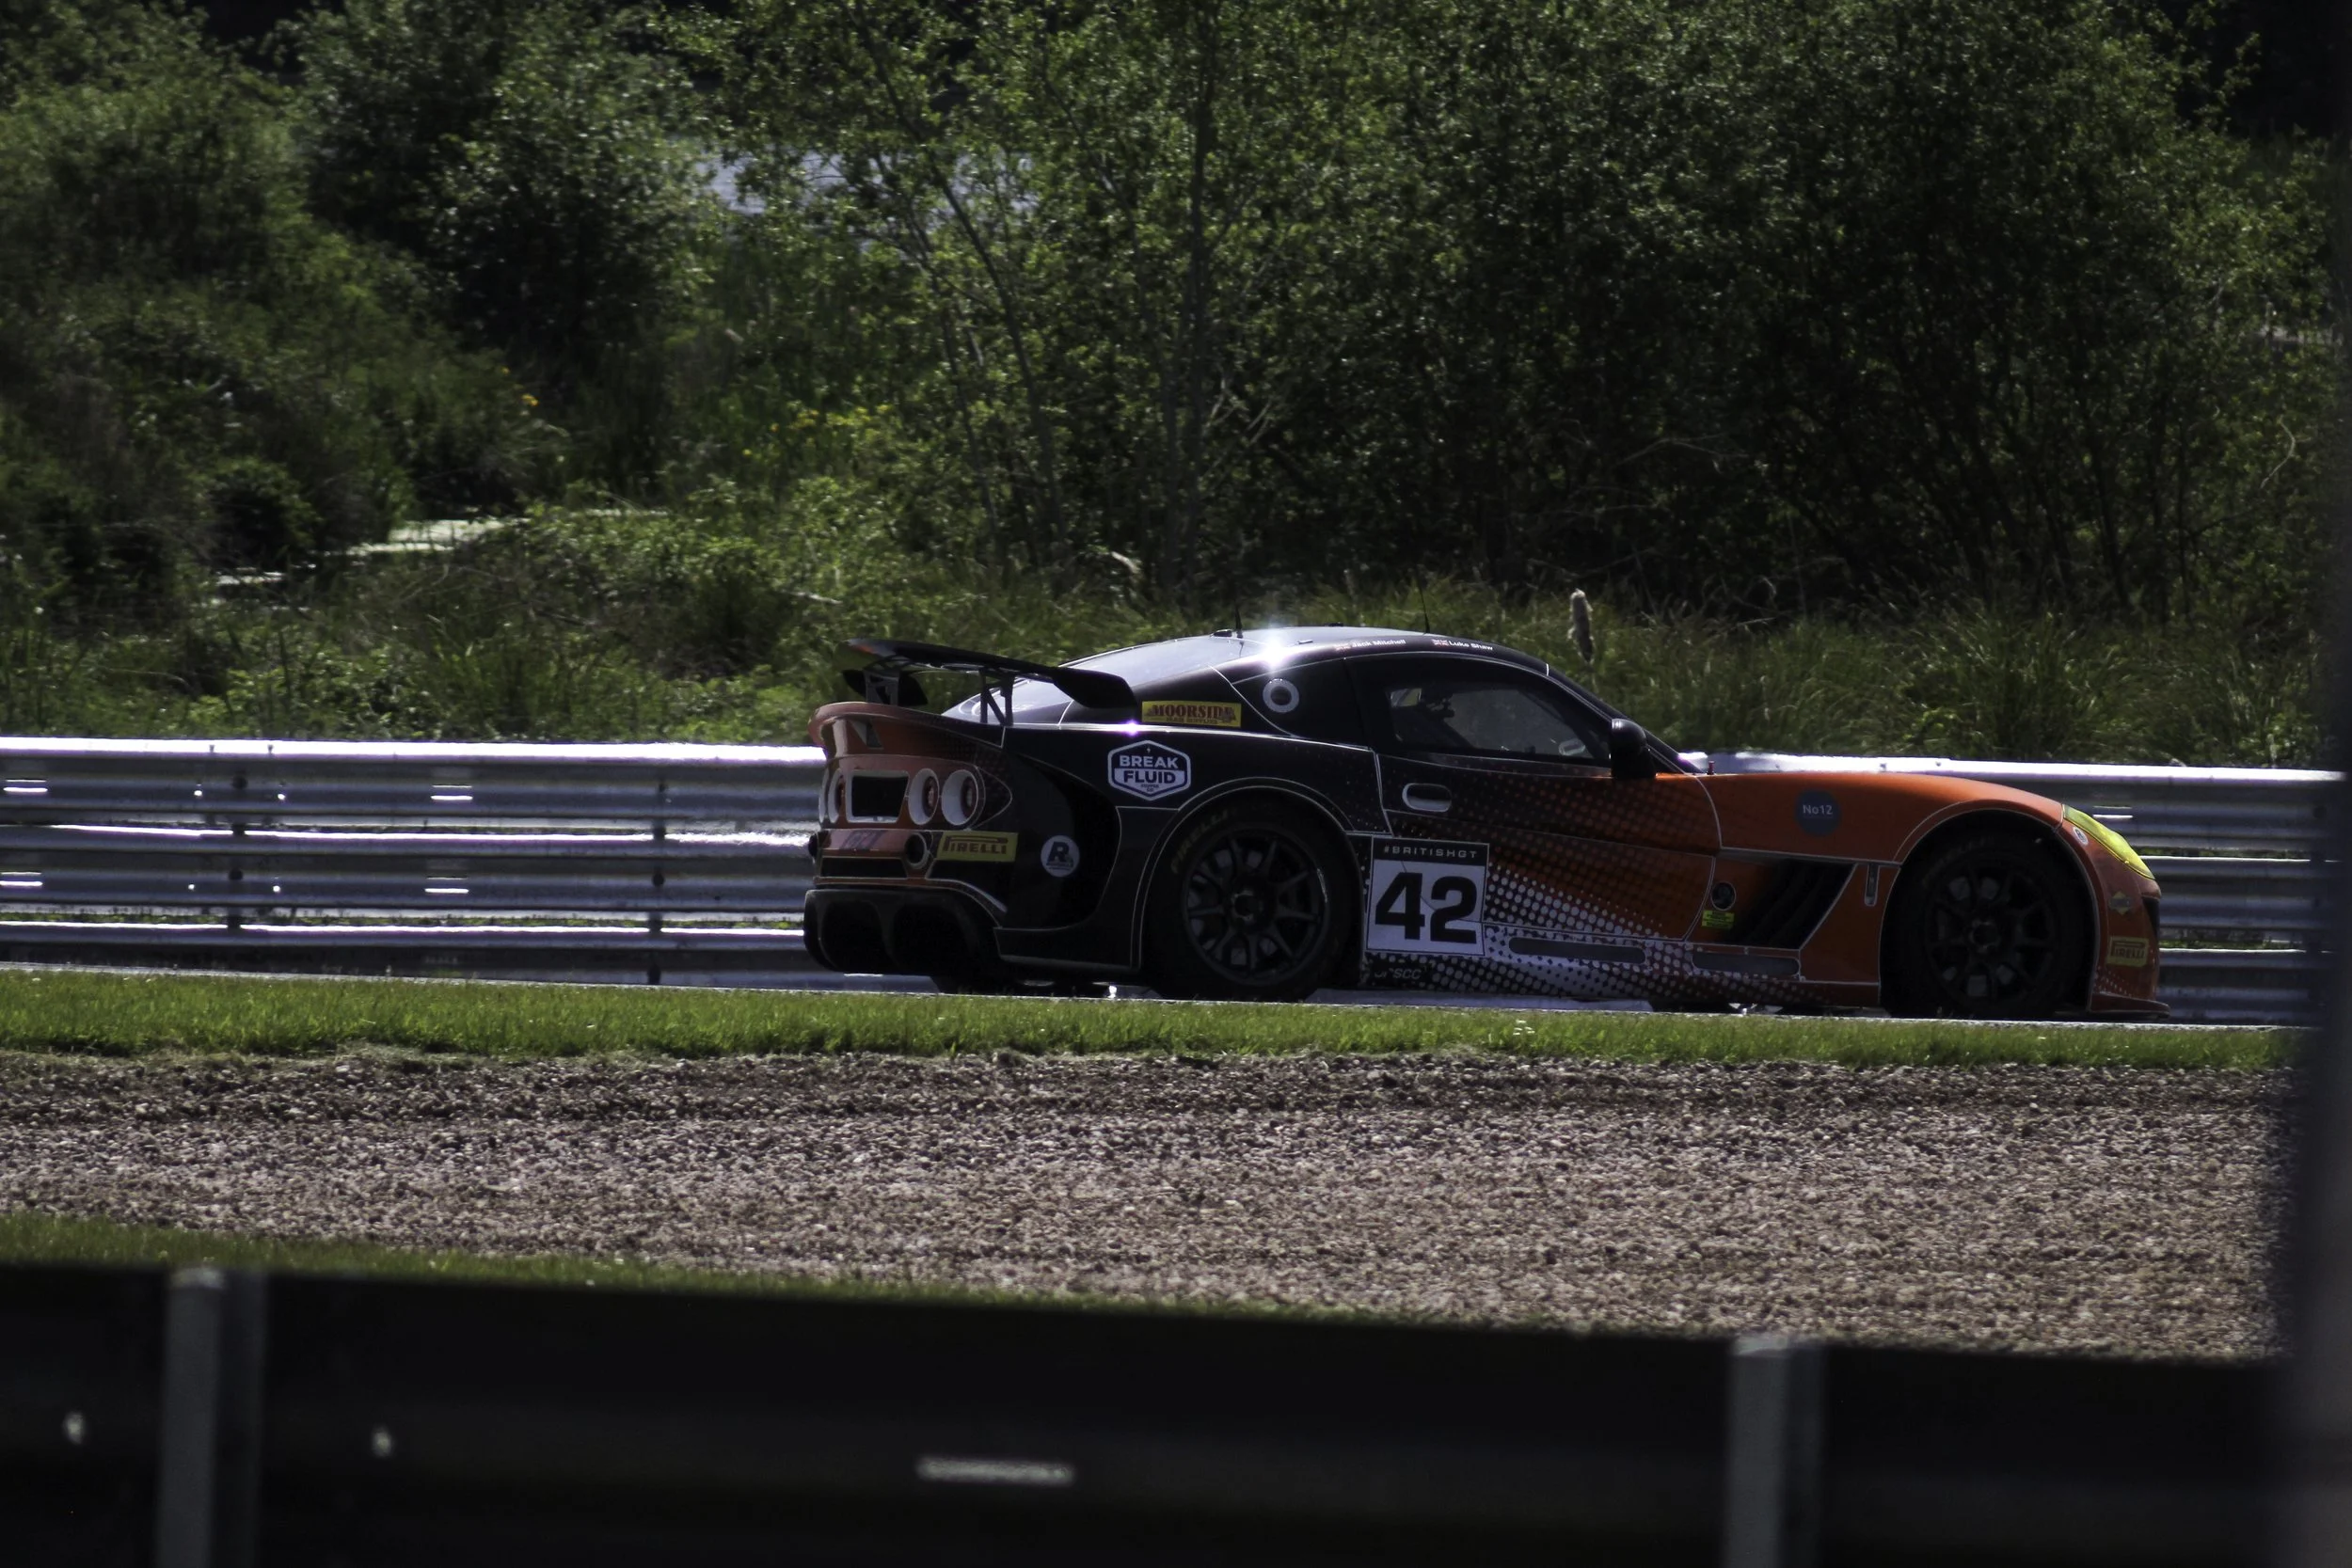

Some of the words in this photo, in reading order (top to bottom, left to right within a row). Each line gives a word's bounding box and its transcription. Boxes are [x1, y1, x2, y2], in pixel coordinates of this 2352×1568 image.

[1352, 640, 1372, 648] Jack
[1470, 642, 1493, 651] Shaw
[1120, 754, 1179, 768] BREAK
[1123, 769, 1176, 784] FLUID
[1803, 804, 1834, 816] No12
[943, 835, 1009, 855] PIRELLI
[1384, 845, 1477, 859] #BRITISHGT
[1375, 872, 1477, 943] 42
[2110, 941, 2146, 958] PIRELLI
